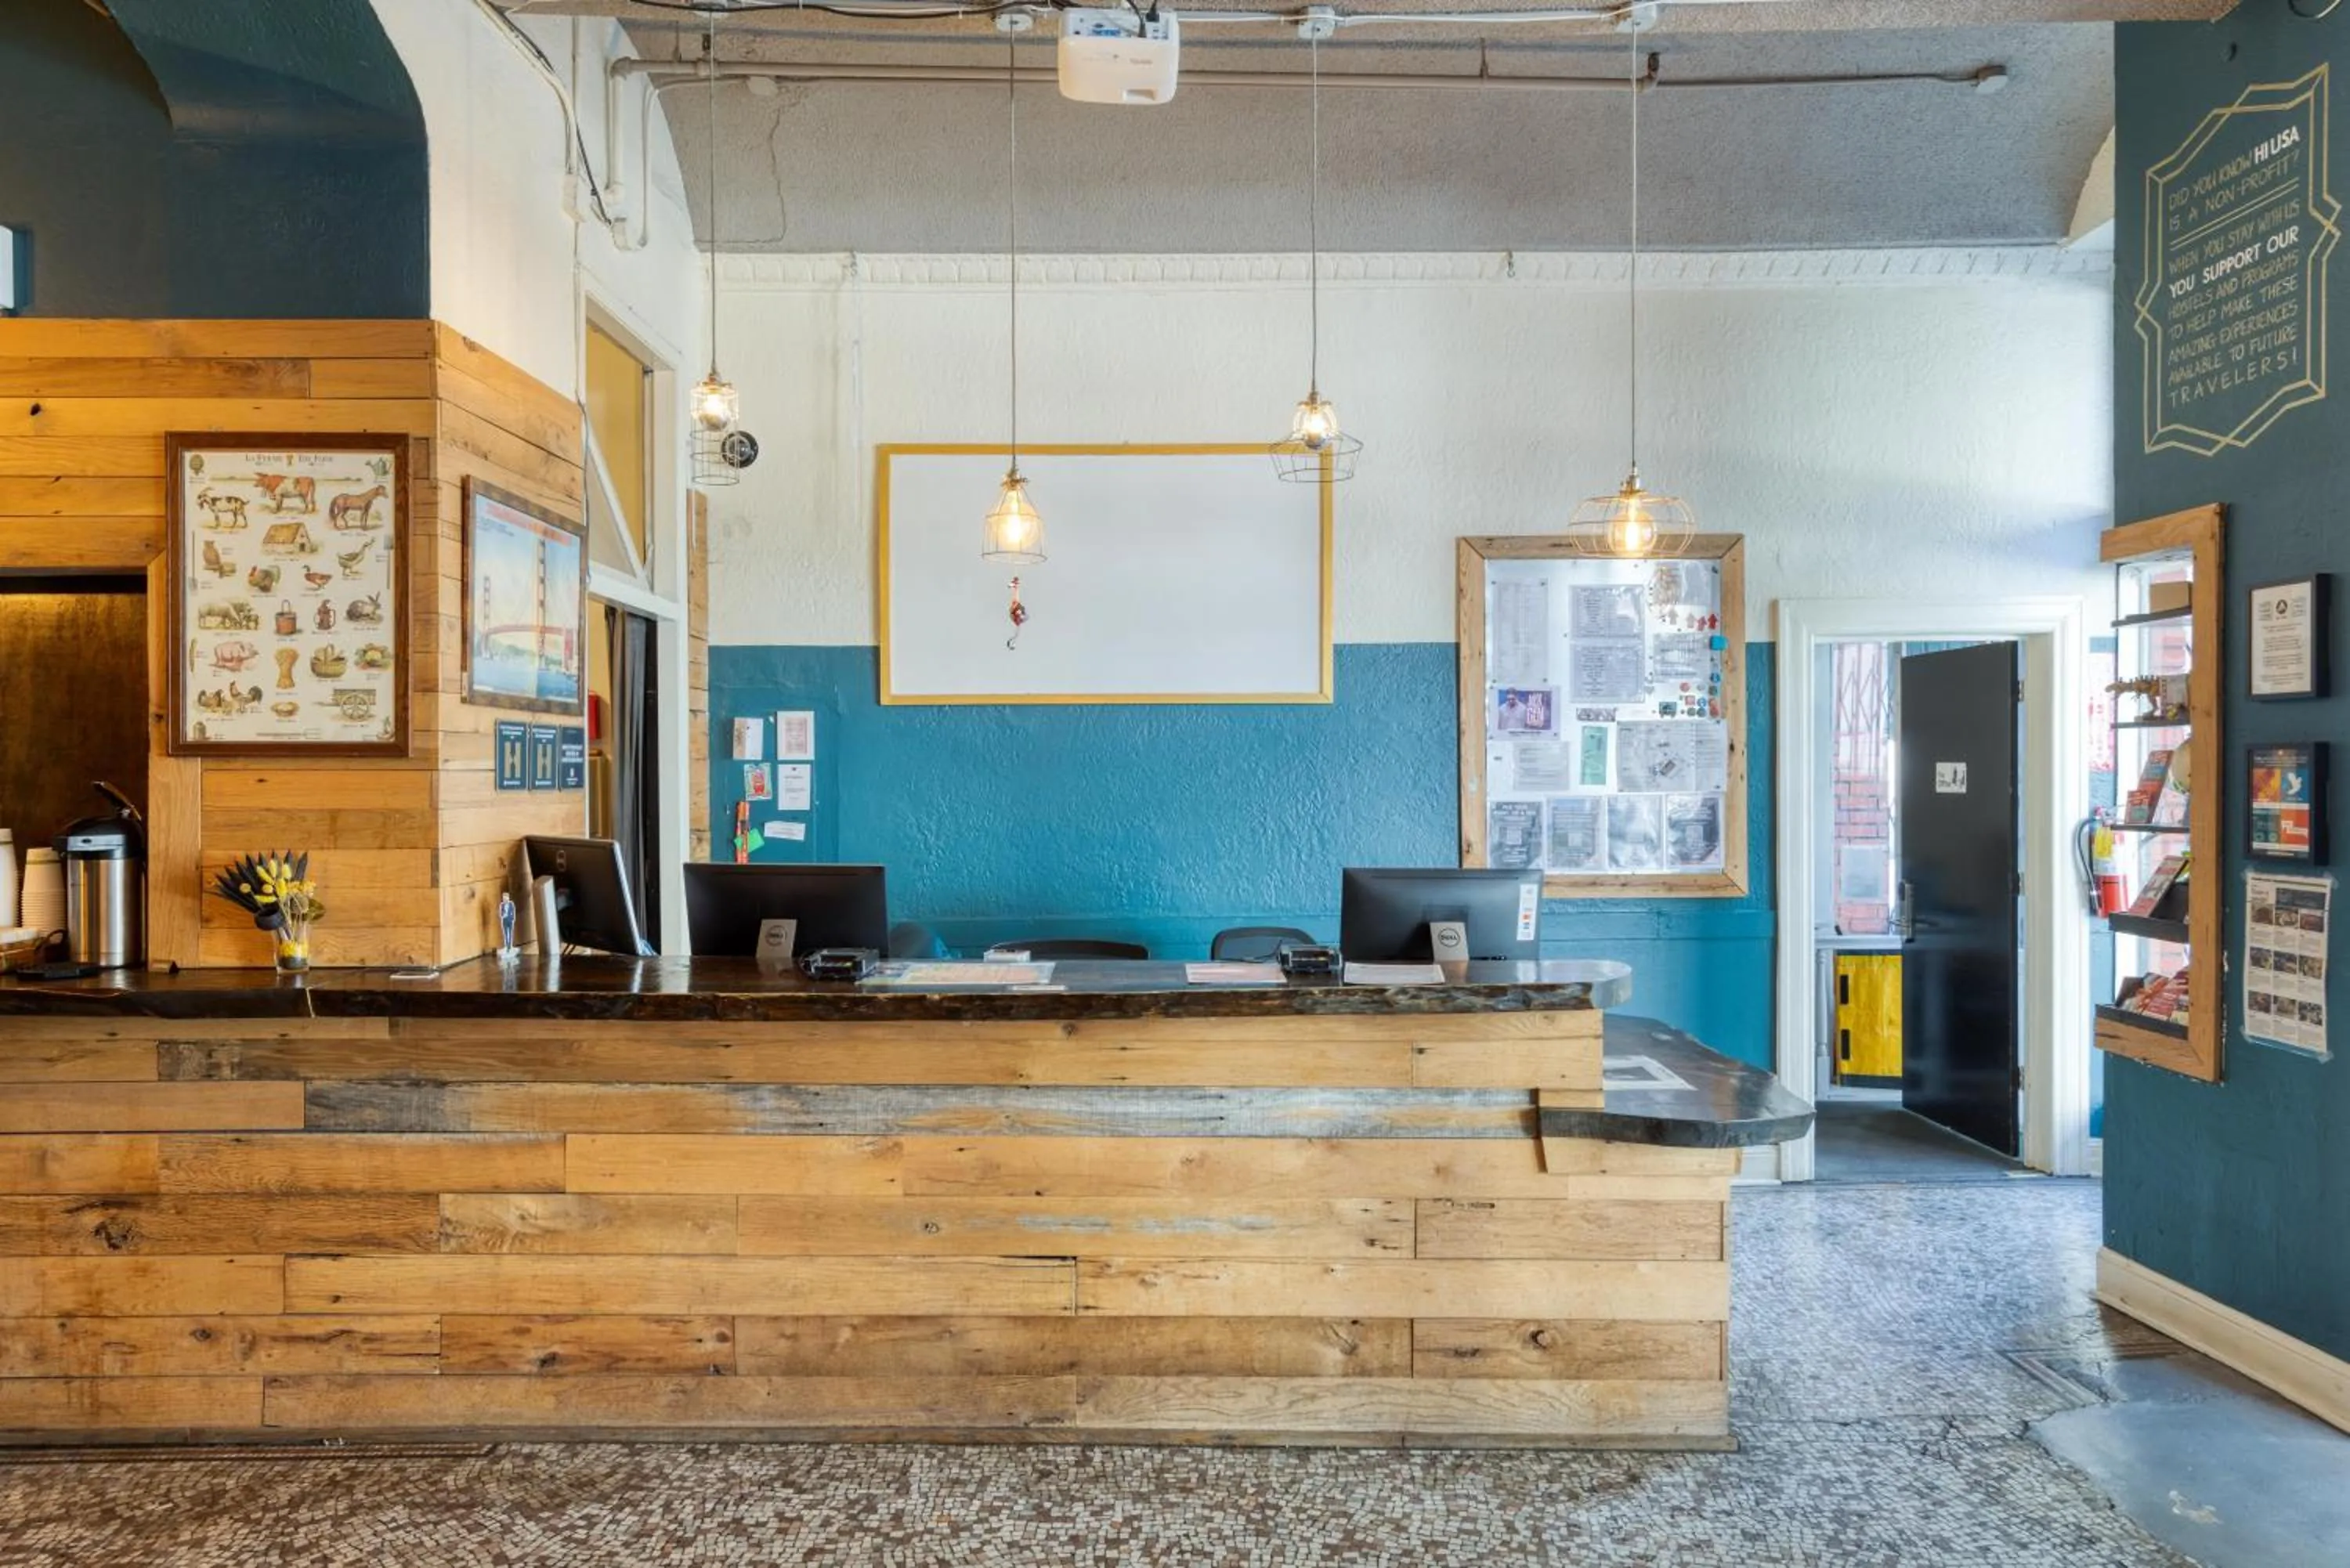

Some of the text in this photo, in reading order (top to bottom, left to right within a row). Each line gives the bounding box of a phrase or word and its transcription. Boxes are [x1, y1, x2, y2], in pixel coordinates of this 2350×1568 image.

[2169, 187, 2190, 211] DID
[2193, 169, 2217, 197] YOU
[2218, 150, 2253, 183] KNOW
[2270, 125, 2301, 155] USA
[2168, 250, 2199, 274] WHEN
[2204, 236, 2225, 260] YOU
[2228, 221, 2255, 248] STAY
[2285, 198, 2300, 219] US
[2169, 215, 2180, 232] IS
[2189, 206, 2199, 222] A
[2168, 226, 2300, 298] YOU SUPPORT OUR
[2168, 249, 2300, 320] HOSTELS AND PROGRAMS
[2168, 273, 2299, 340] TO HELP MAKE THESE
[2168, 298, 2299, 366] AMAZING EXPERIENCES
[2168, 322, 2298, 386] AVAILABLE TO FUTURE
[2169, 346, 2298, 408] TRAVELERS!
